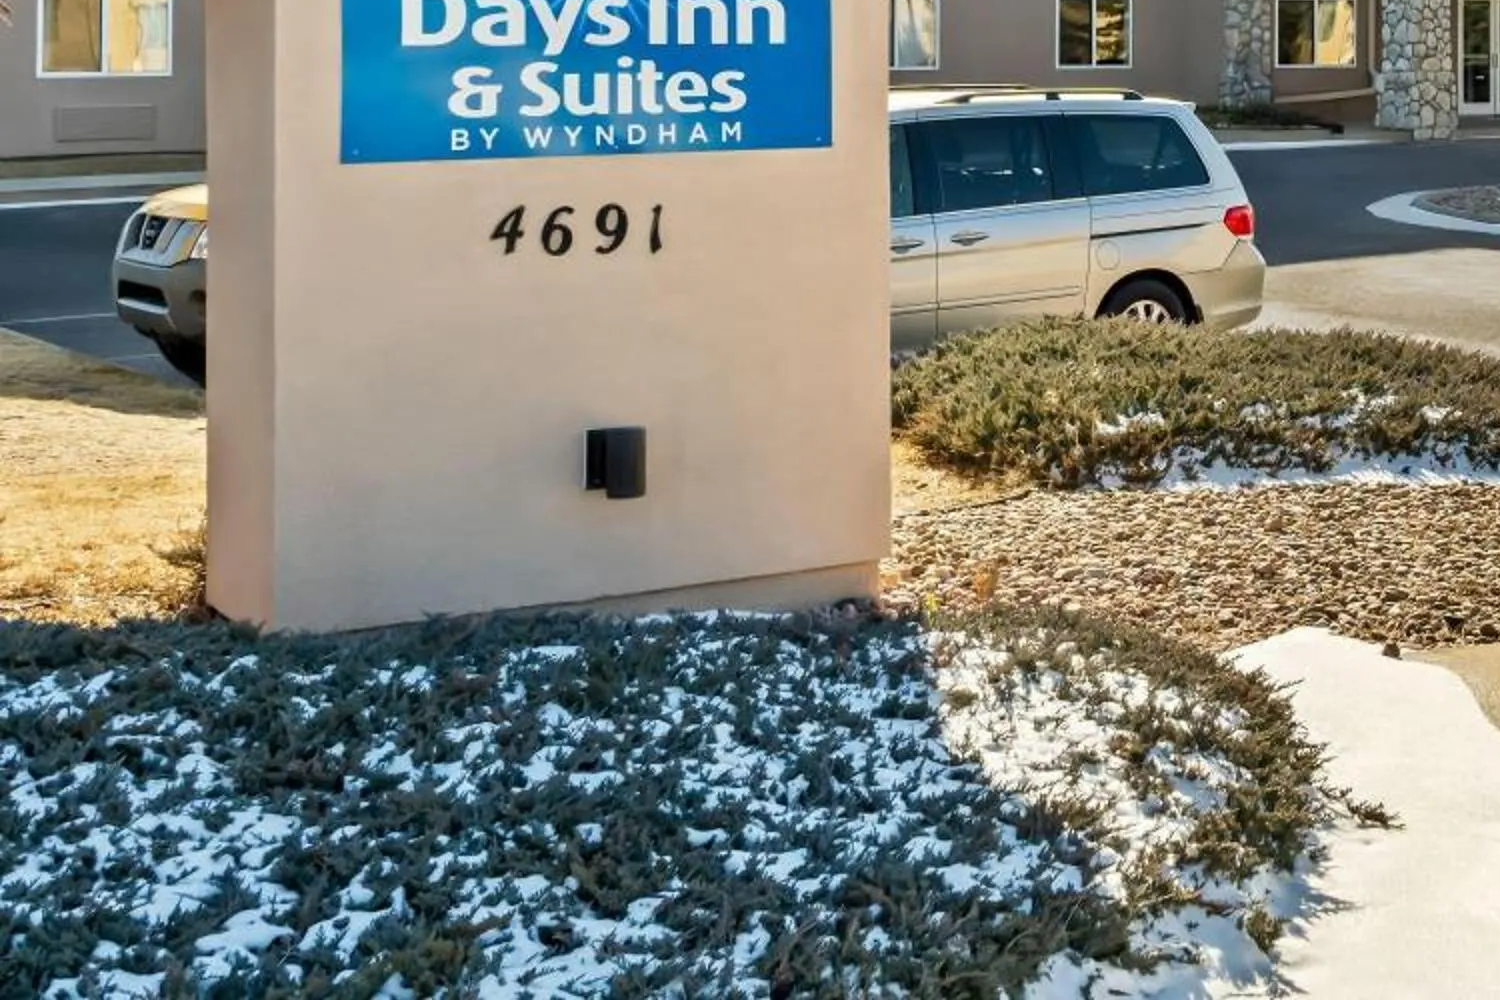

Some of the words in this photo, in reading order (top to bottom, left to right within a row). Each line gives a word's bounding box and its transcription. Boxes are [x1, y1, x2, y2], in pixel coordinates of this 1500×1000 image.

[448, 66, 503, 119] &
[519, 56, 748, 117] Suites
[451, 127, 500, 152] BY
[524, 121, 743, 149] WYNDHAM
[489, 203, 664, 257] 4691
